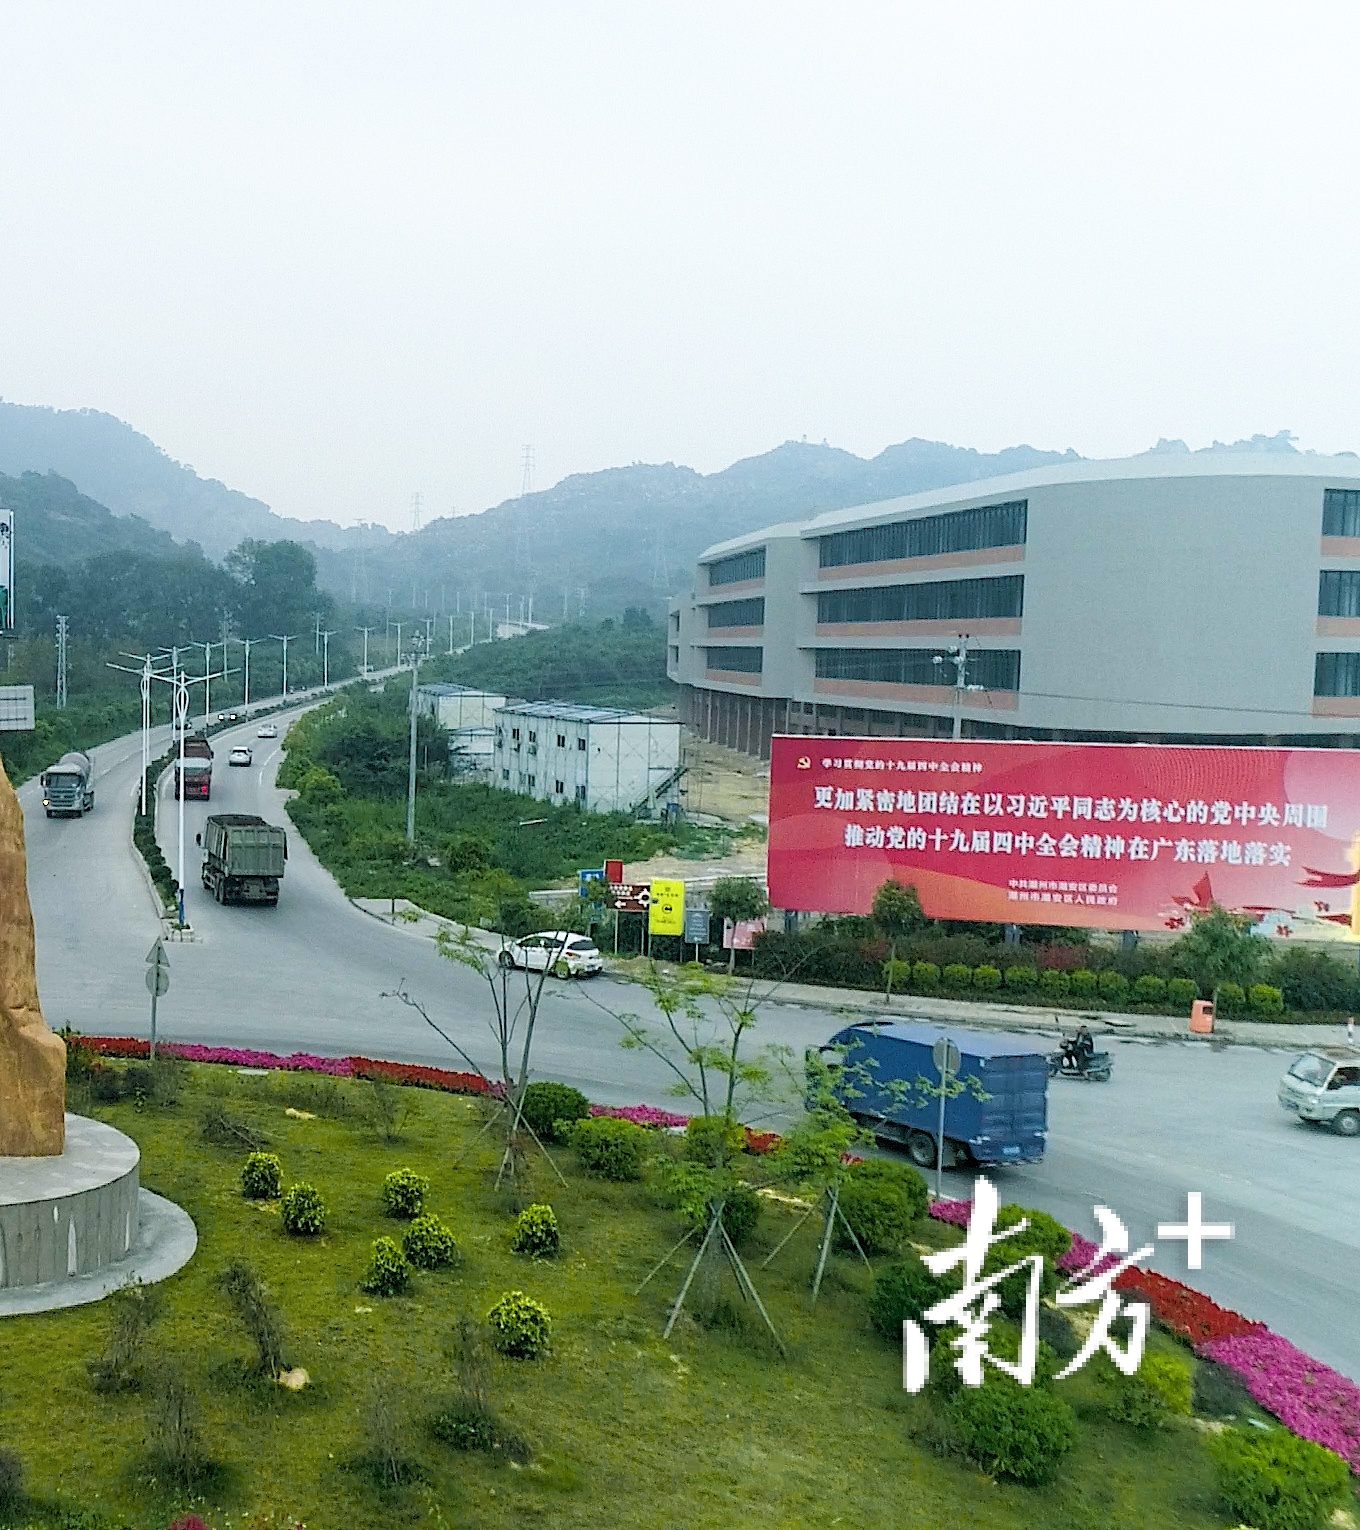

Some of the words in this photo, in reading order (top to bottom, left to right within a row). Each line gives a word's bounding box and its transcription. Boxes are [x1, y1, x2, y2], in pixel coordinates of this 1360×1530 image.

[814, 786, 1328, 828] 更加紧密地团结在以习近平同志为核心的党中央周围
[844, 824, 1292, 867] 推动党的十九届四中全会精神在广东落地落实
